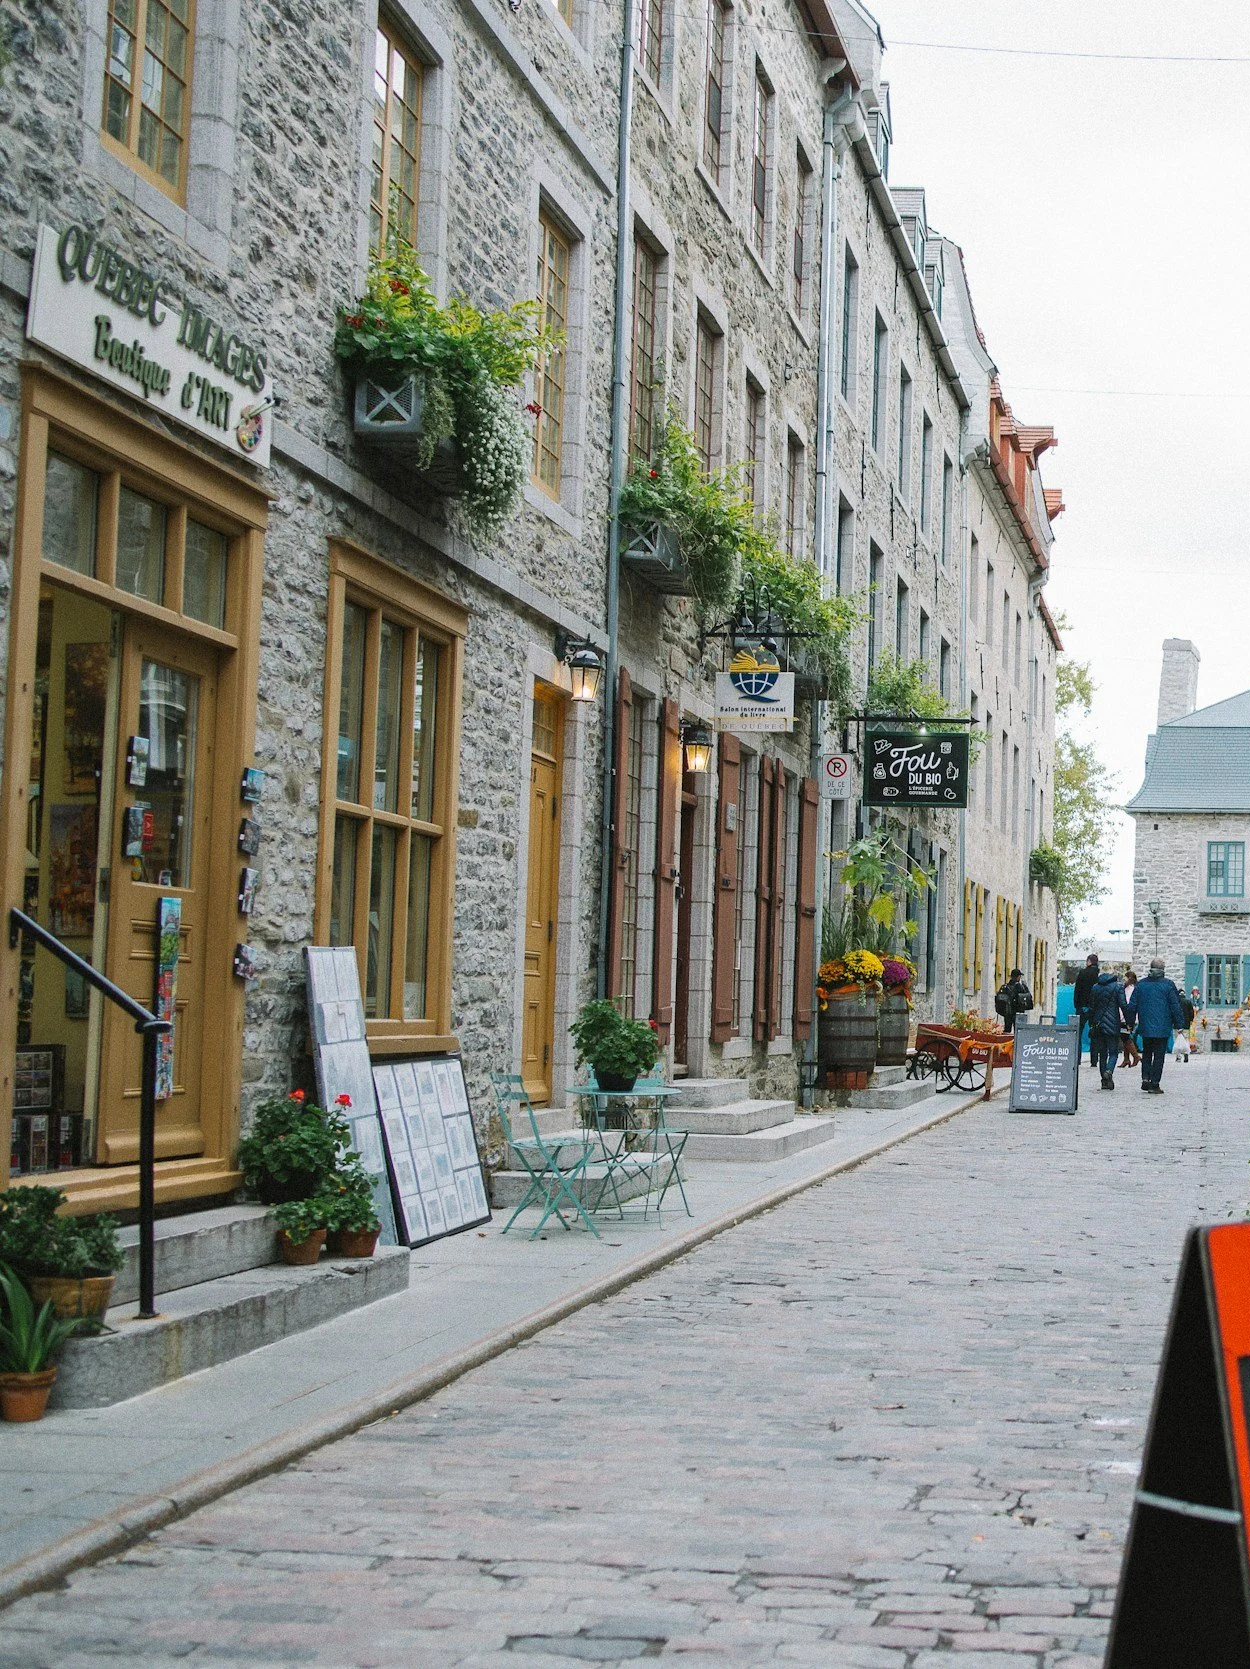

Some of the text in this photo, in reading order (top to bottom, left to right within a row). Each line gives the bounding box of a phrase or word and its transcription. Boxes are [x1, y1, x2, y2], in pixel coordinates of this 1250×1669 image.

[176, 296, 267, 393] IMAGES
[95, 315, 233, 431] Boutique d'ART
[889, 743, 941, 777] Fou
[827, 780, 835, 788] DE
[908, 773, 942, 785] DU BIO
[1022, 1043, 1046, 1058] Fou
[1058, 1048, 1069, 1056] BIO
